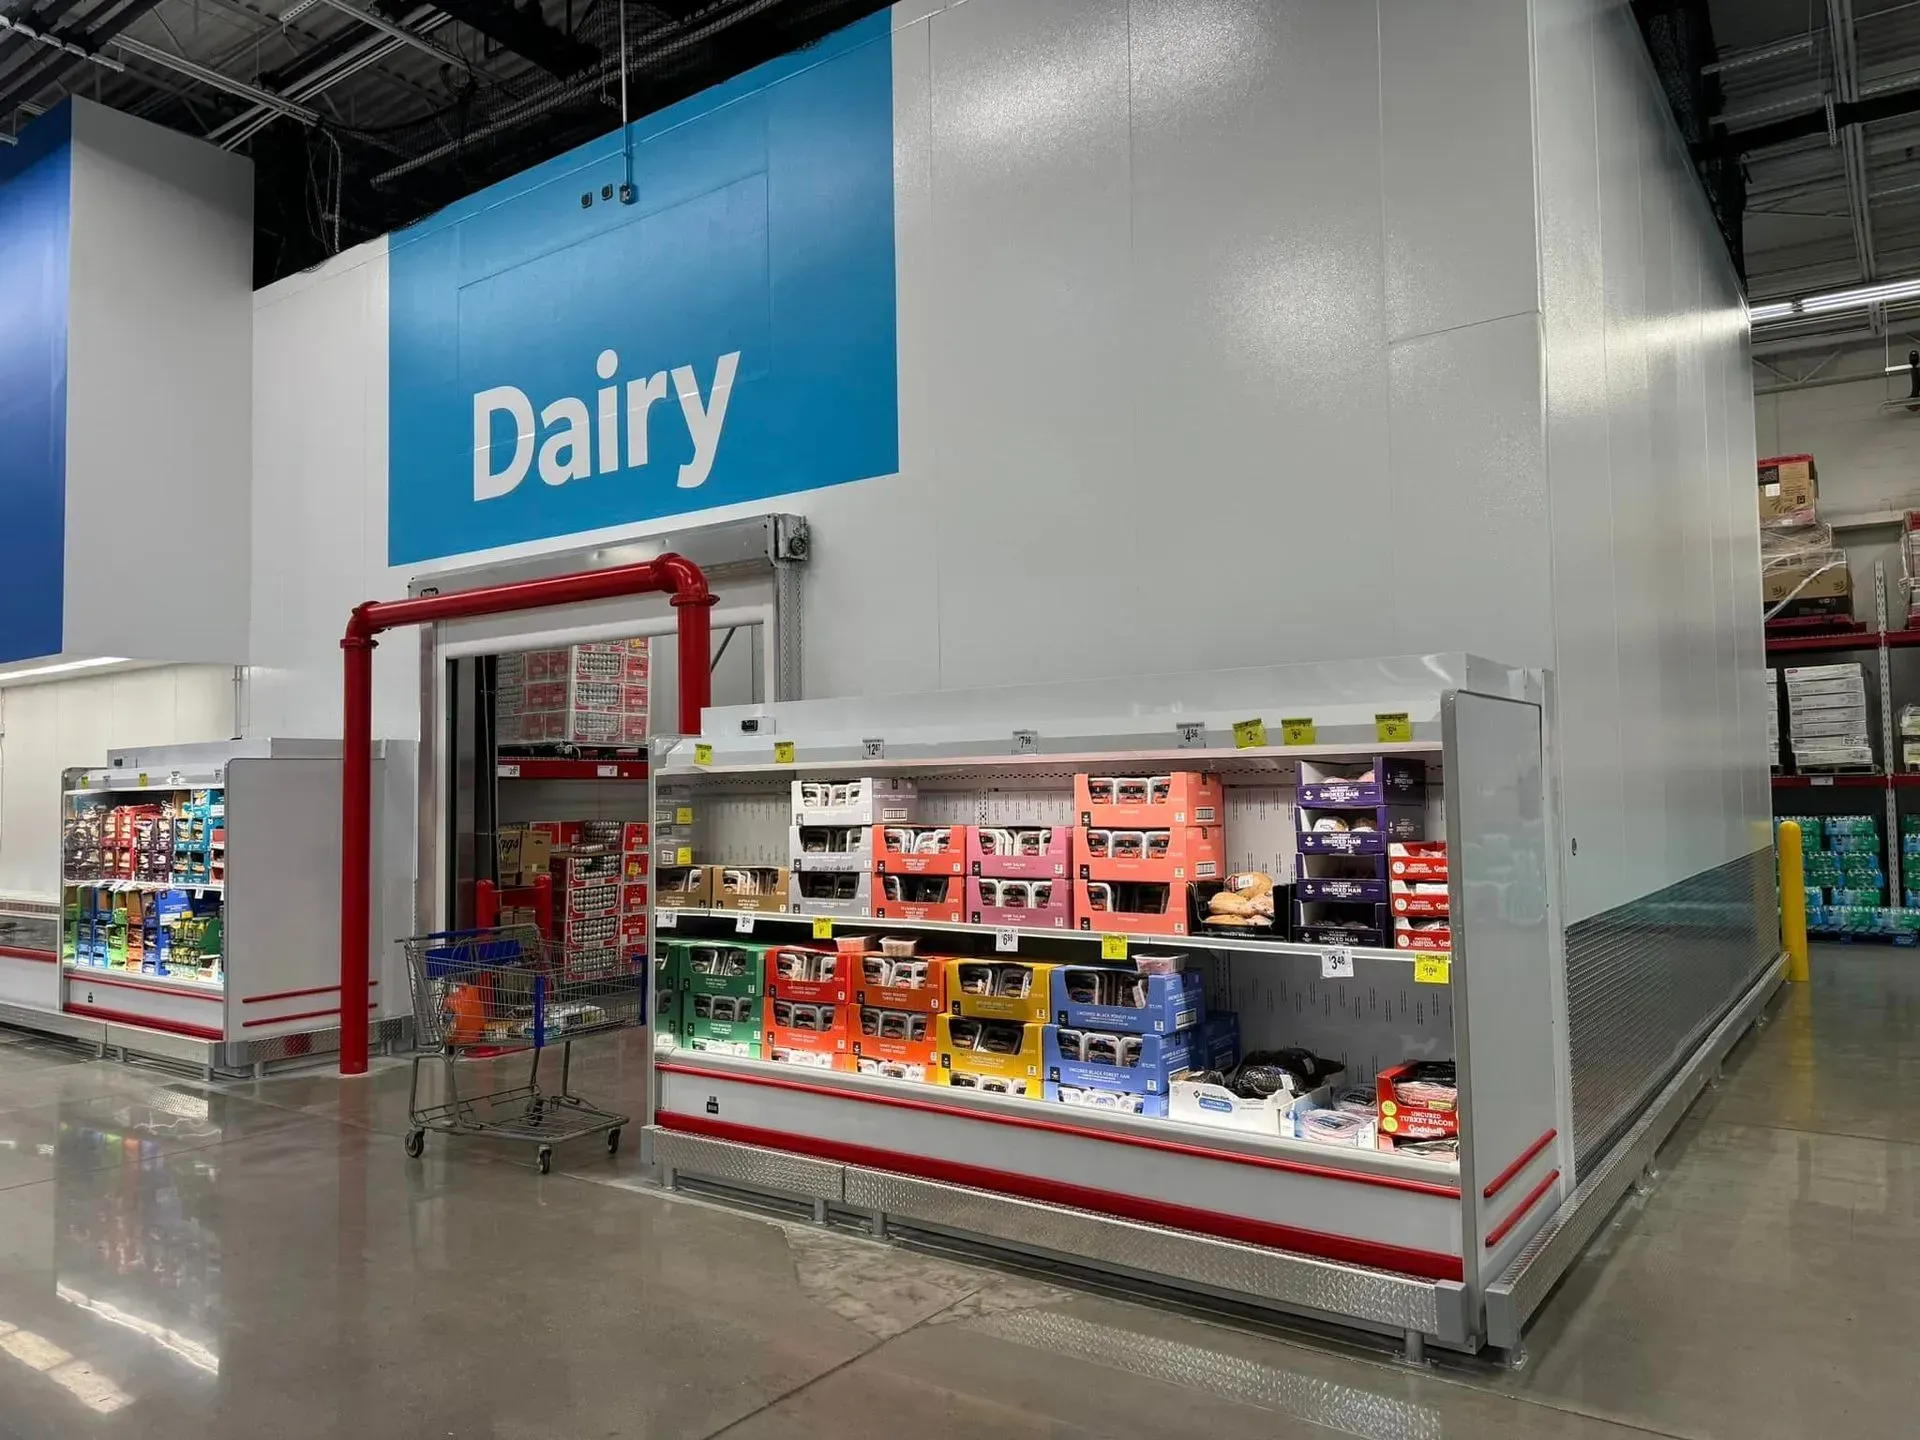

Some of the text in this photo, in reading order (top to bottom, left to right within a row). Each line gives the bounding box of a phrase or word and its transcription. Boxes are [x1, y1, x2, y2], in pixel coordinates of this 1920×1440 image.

[474, 349, 741, 502] Dairy
[1399, 1114, 1454, 1127] TURKEY BACON
[1410, 1111, 1442, 1119] UNCURED
